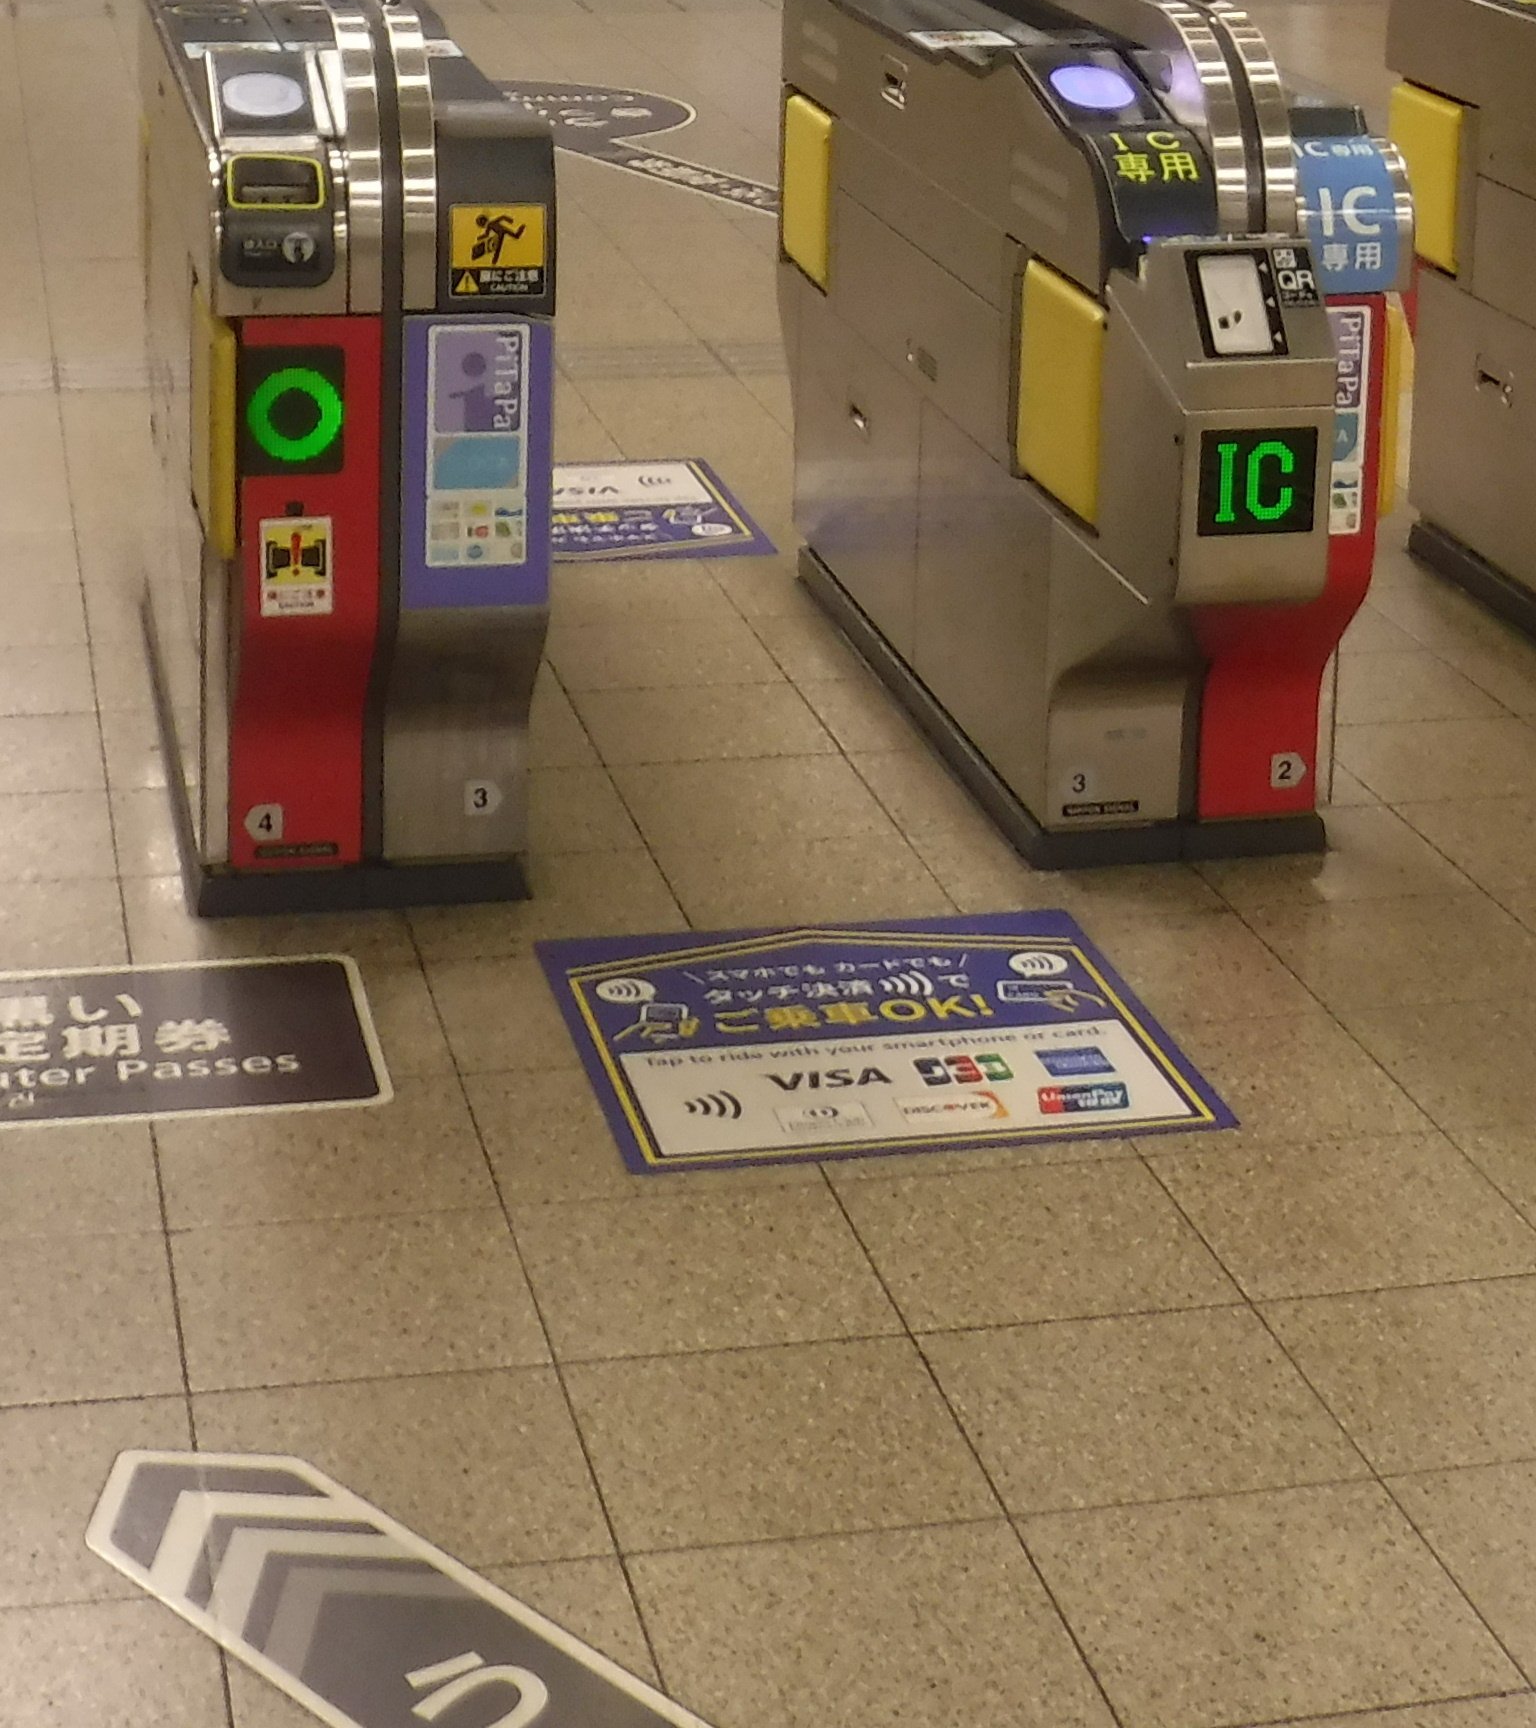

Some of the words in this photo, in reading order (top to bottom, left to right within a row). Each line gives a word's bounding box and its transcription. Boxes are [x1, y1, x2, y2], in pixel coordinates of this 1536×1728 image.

[1109, 130, 1181, 152] IC
[1112, 150, 1202, 185] 専用
[1319, 185, 1381, 237] IC
[1322, 242, 1383, 272] 専用
[1277, 269, 1315, 291] QR
[1336, 315, 1362, 406] PiTaPa
[492, 331, 520, 431] PiTaPa
[1215, 441, 1294, 522] IC
[1072, 773, 1086, 793] 3
[1277, 760, 1292, 780] 2
[473, 787, 489, 809] 3
[258, 813, 273, 833] 4
[714, 993, 995, 1034] ご乗車OK!
[646, 1055, 684, 1069] Tap
[689, 1053, 713, 1065] to
[719, 1048, 763, 1063] ride
[769, 1044, 820, 1060] with
[824, 1041, 875, 1057] your
[881, 1031, 1019, 1052] smartphone
[1023, 1031, 1045, 1042] or
[115, 1052, 301, 1084] Passes
[764, 1065, 893, 1093] VISA
[914, 1052, 1015, 1088] JCB
[902, 1099, 991, 1117] DISCOVER
[1040, 1086, 1124, 1104] UnionPay
